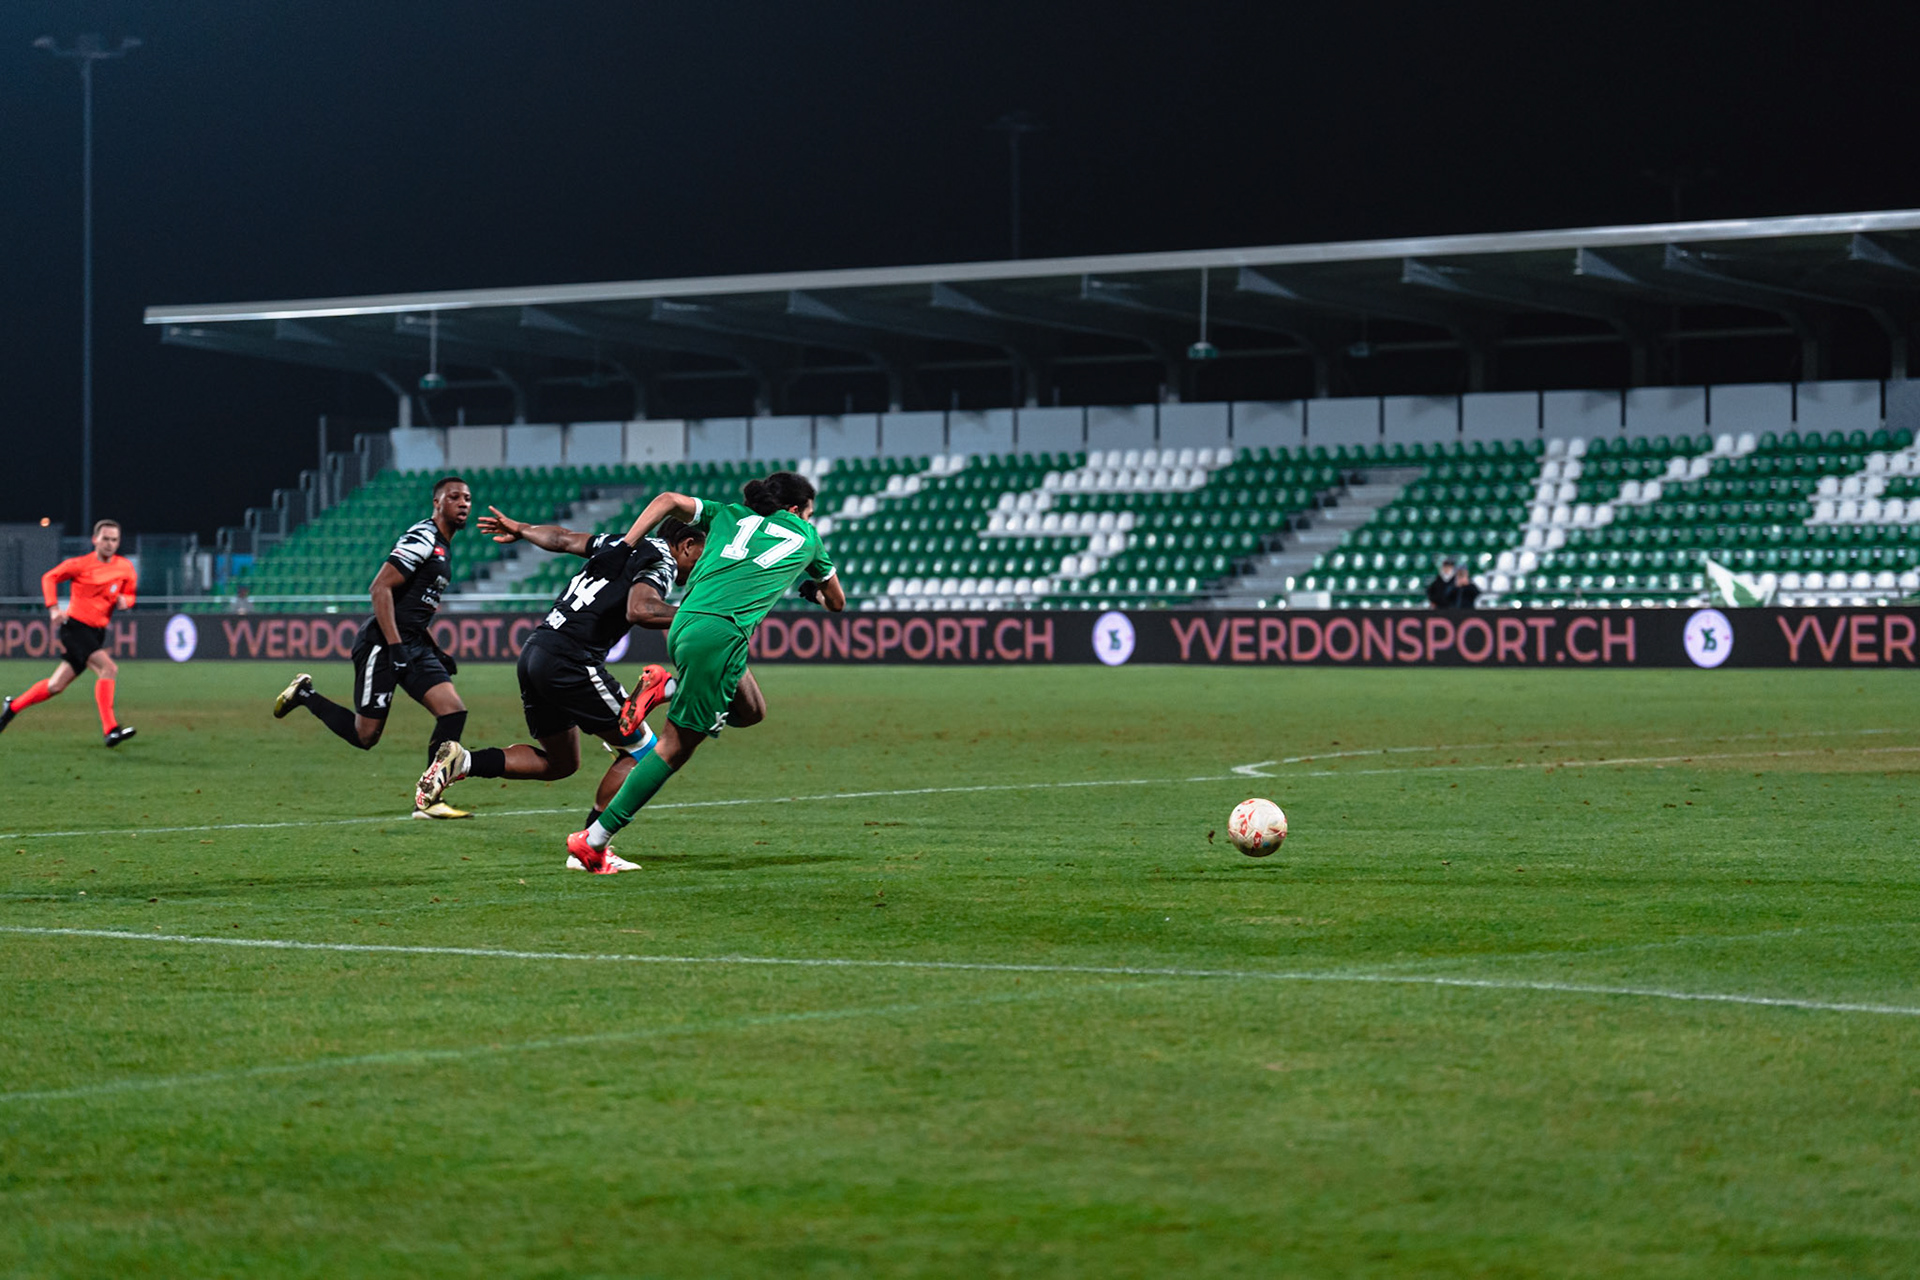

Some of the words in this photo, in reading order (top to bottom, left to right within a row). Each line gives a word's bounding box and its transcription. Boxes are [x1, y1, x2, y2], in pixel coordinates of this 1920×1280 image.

[720, 515, 806, 570] 17
[748, 617, 1054, 660] DONSPORT.CH
[1170, 616, 1636, 663] YVERDONSPORT.CH
[1776, 614, 1916, 663] YVER
